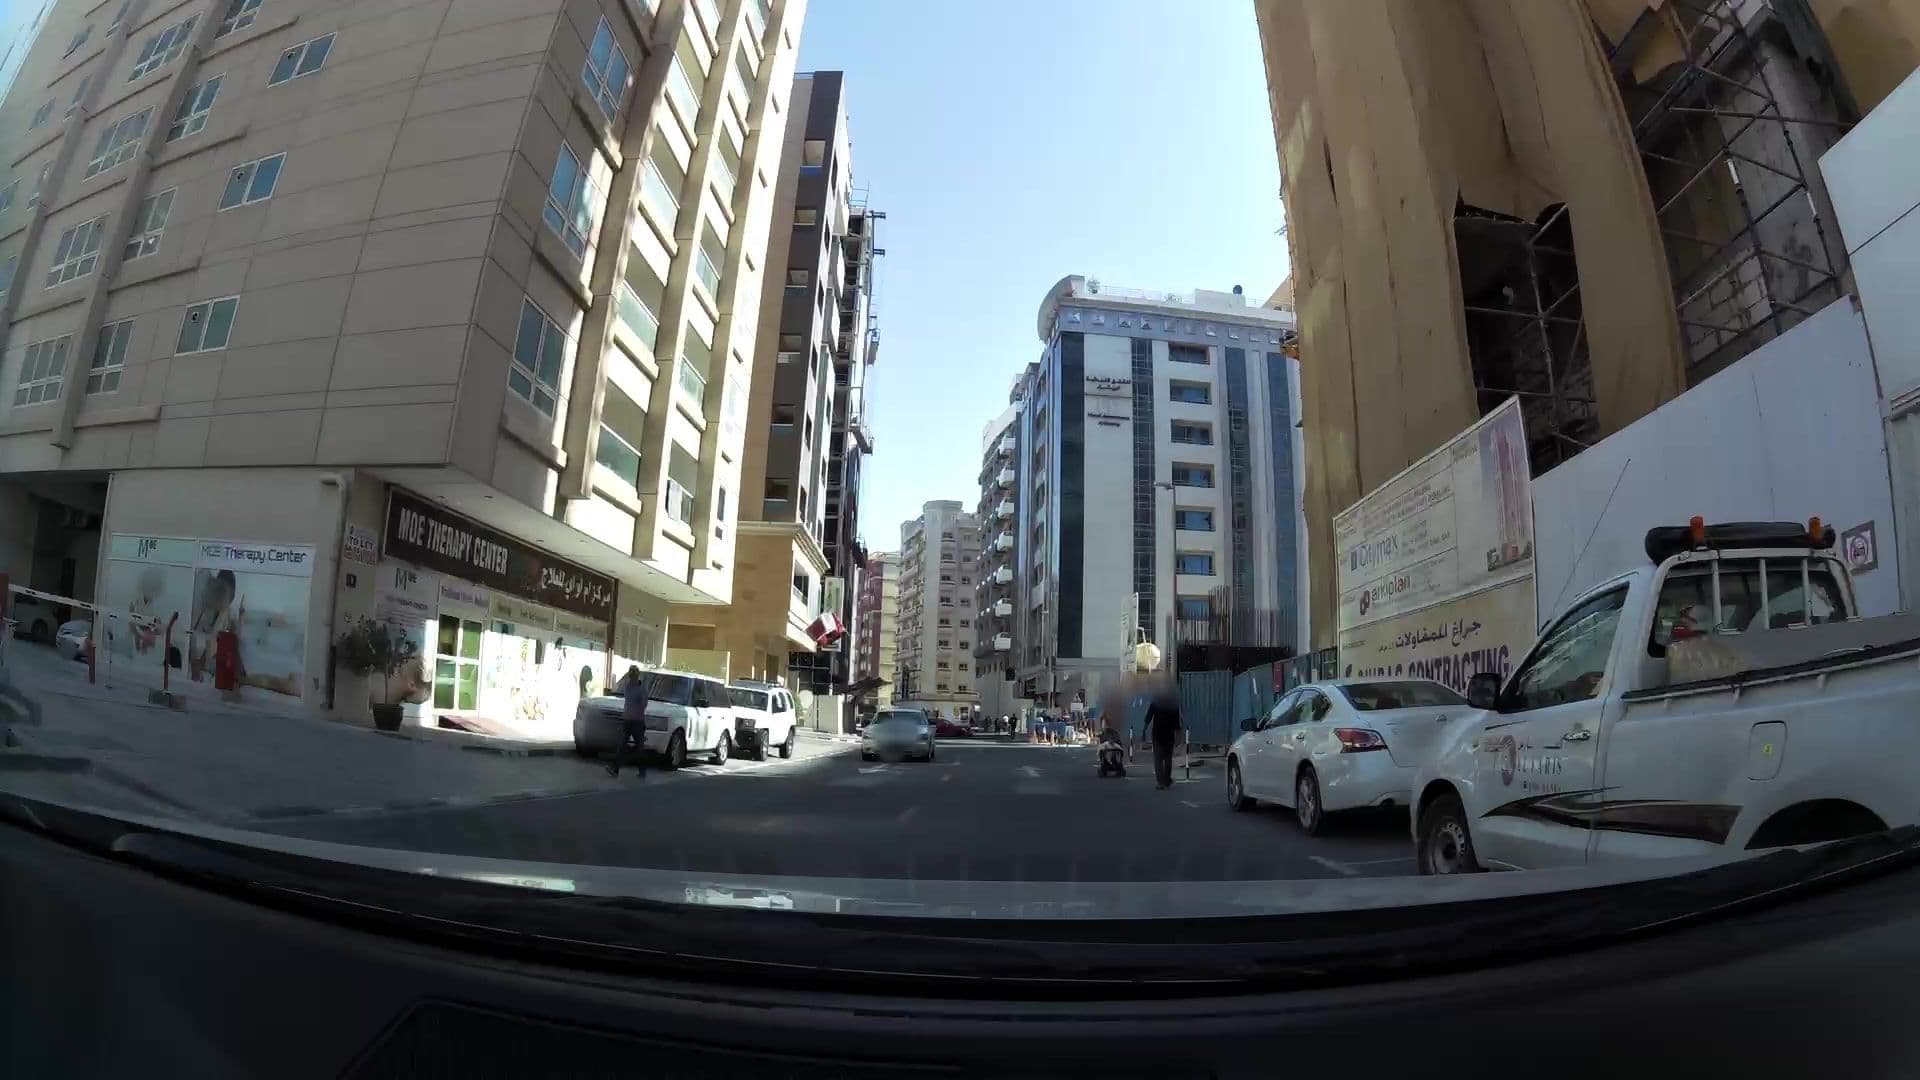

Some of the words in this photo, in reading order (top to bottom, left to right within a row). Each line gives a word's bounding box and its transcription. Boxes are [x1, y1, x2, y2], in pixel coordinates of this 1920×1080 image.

[224, 546, 266, 563] Therapy
[268, 549, 307, 563] Center
[398, 507, 426, 546] MOE
[427, 517, 473, 562] THERAPY
[473, 537, 508, 577] CENTER
